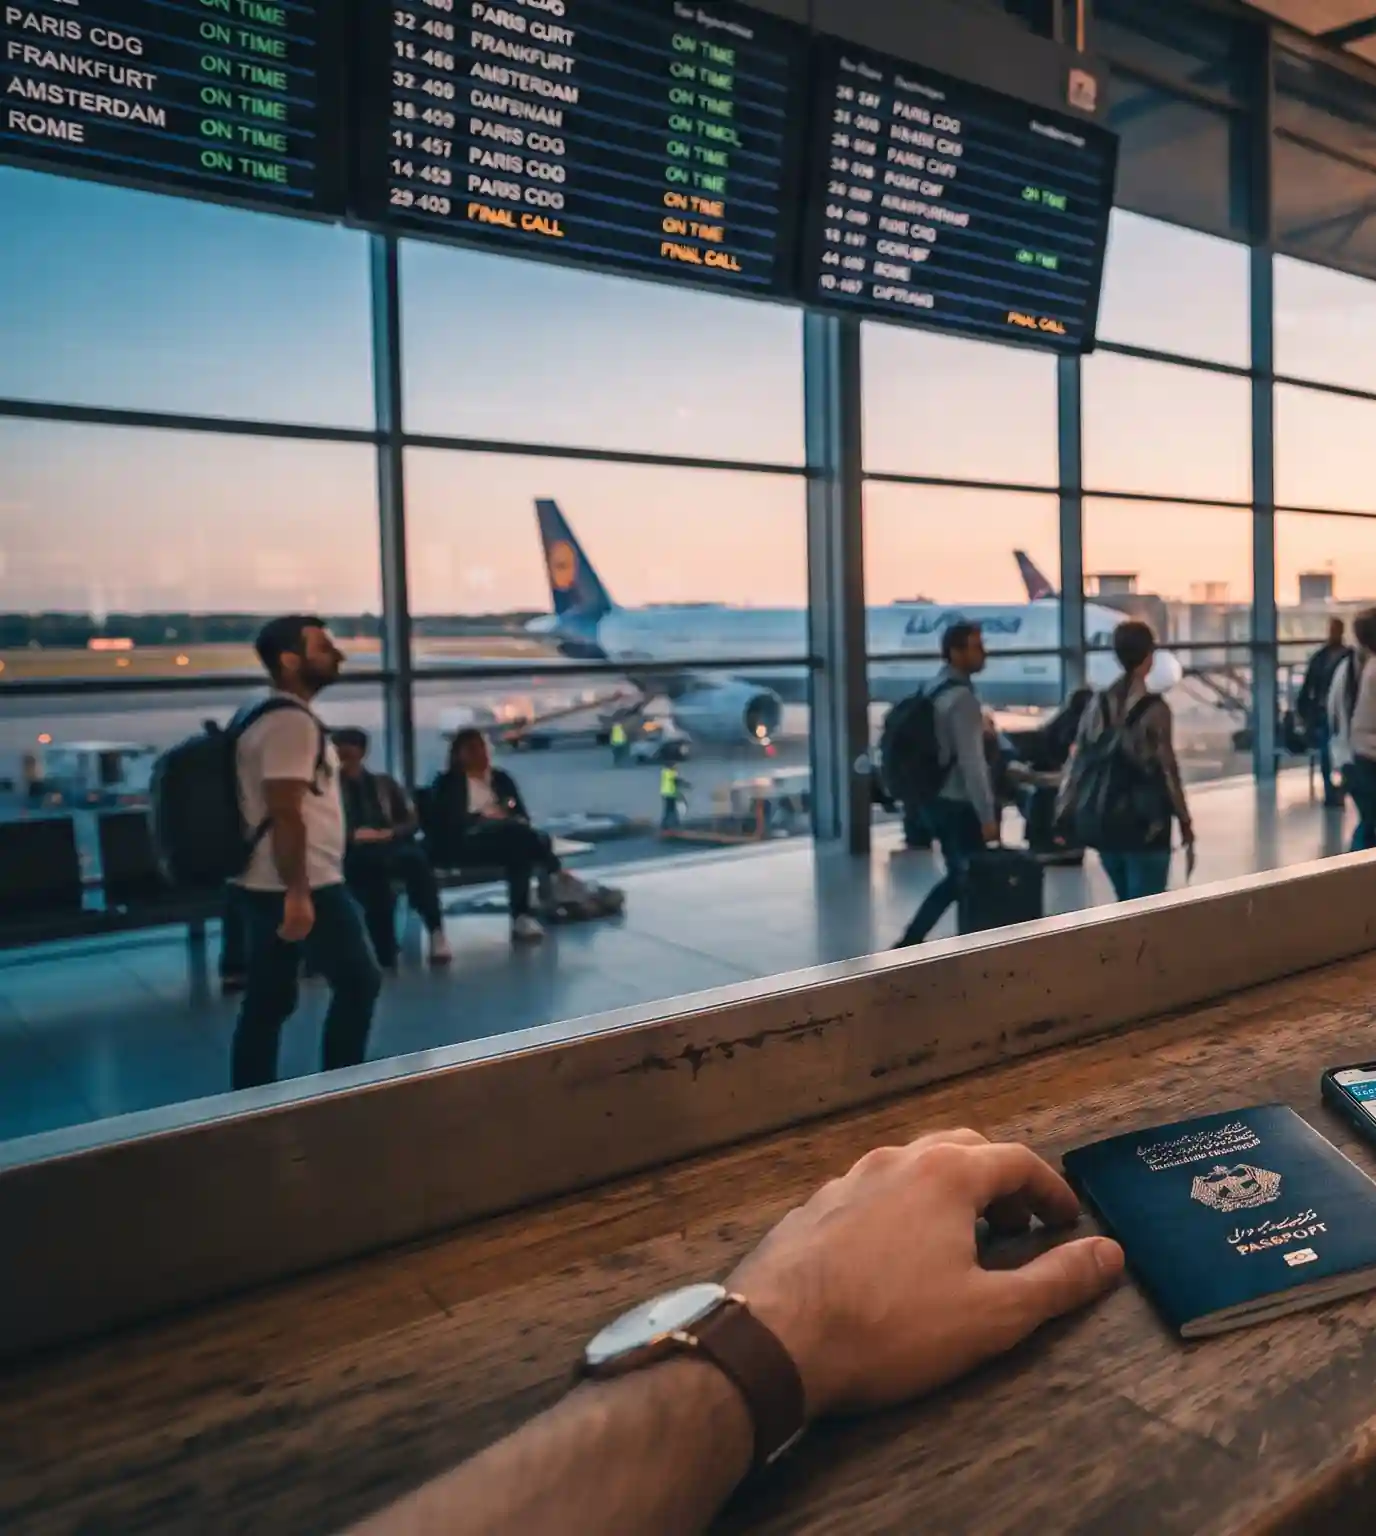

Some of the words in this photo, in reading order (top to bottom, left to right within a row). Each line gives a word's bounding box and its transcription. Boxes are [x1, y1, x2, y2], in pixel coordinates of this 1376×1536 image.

[6, 6, 82, 40] PARIS
[89, 27, 143, 56] CDG
[199, 22, 231, 44] ON
[238, 31, 285, 58] TIME
[6, 39, 157, 93] FRANKFURT
[469, 28, 575, 76] FRANKFURT
[672, 34, 697, 53] ON
[701, 41, 734, 66] TIME
[200, 55, 231, 76] ON
[238, 63, 287, 91] TIME
[669, 62, 696, 79] ON
[700, 67, 732, 90] TIME
[6, 74, 166, 130] AMSTERDAM
[200, 87, 232, 108] ON
[238, 94, 285, 120] TIME
[668, 87, 695, 106] ON
[698, 94, 733, 117] TIME
[9, 109, 84, 143] ROME
[200, 119, 233, 140] ON
[237, 125, 286, 152] TIME
[469, 117, 524, 146] PARIS
[668, 114, 693, 132] ON
[200, 150, 233, 172] ON
[238, 158, 287, 183] TIME
[468, 146, 524, 174] PARIS
[666, 140, 690, 158] ON
[693, 146, 727, 166] TIME
[665, 166, 689, 183] ON
[663, 191, 688, 209] ON
[467, 203, 516, 228] FINAL
[521, 213, 564, 237] CALL
[662, 217, 687, 235] ON
[704, 249, 741, 271] CALL
